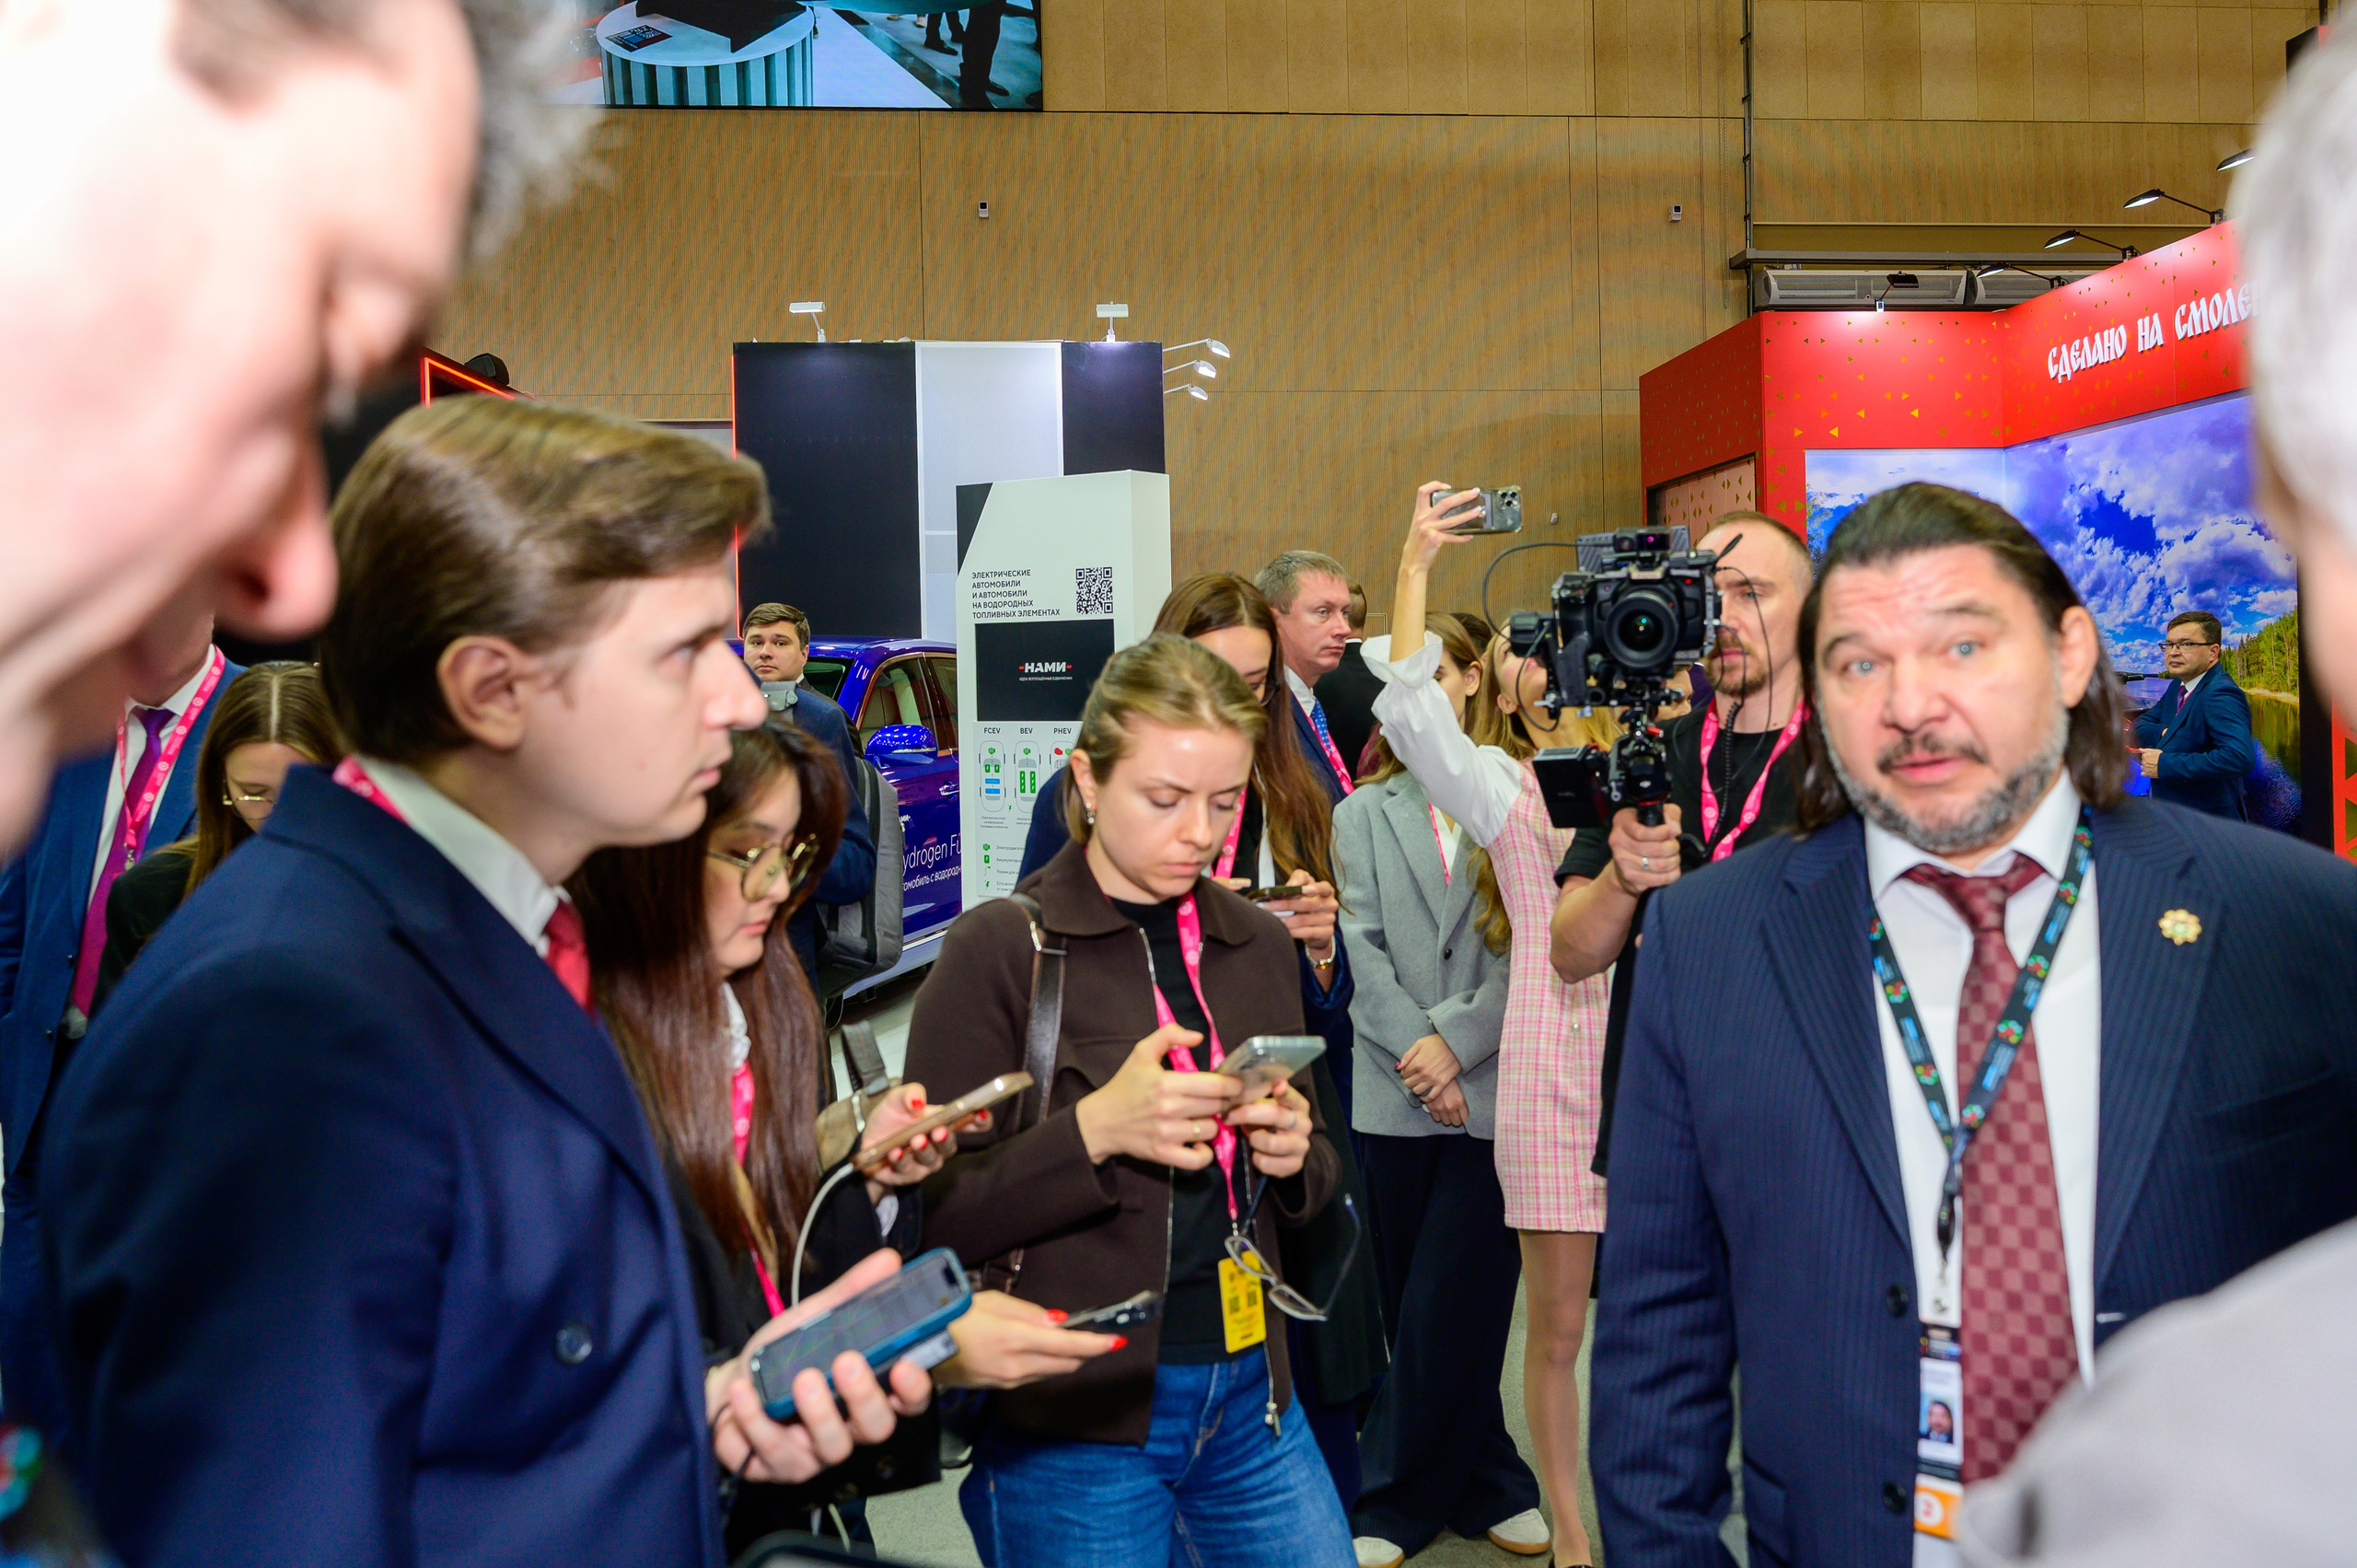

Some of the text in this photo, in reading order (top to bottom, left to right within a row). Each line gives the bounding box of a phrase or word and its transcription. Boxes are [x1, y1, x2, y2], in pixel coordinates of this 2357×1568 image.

[2048, 325, 2127, 384] СДЕЛАНО
[2137, 313, 2165, 353] НА
[971, 569, 1031, 579] ЭЛЕКТРИЧЕСКИЕ
[971, 580, 1021, 589] АВТОМОБИЛИ
[978, 590, 1028, 598] АВТОМОБИЛИ
[982, 599, 1034, 609] ВОДОРОДНЫХ
[972, 609, 1061, 619] ТОПЛИВНЫХ ЭЛЕМЕНТАХ
[902, 833, 961, 877] ydrogen Fu
[902, 875, 930, 891] омобиль
[930, 873, 935, 882] с
